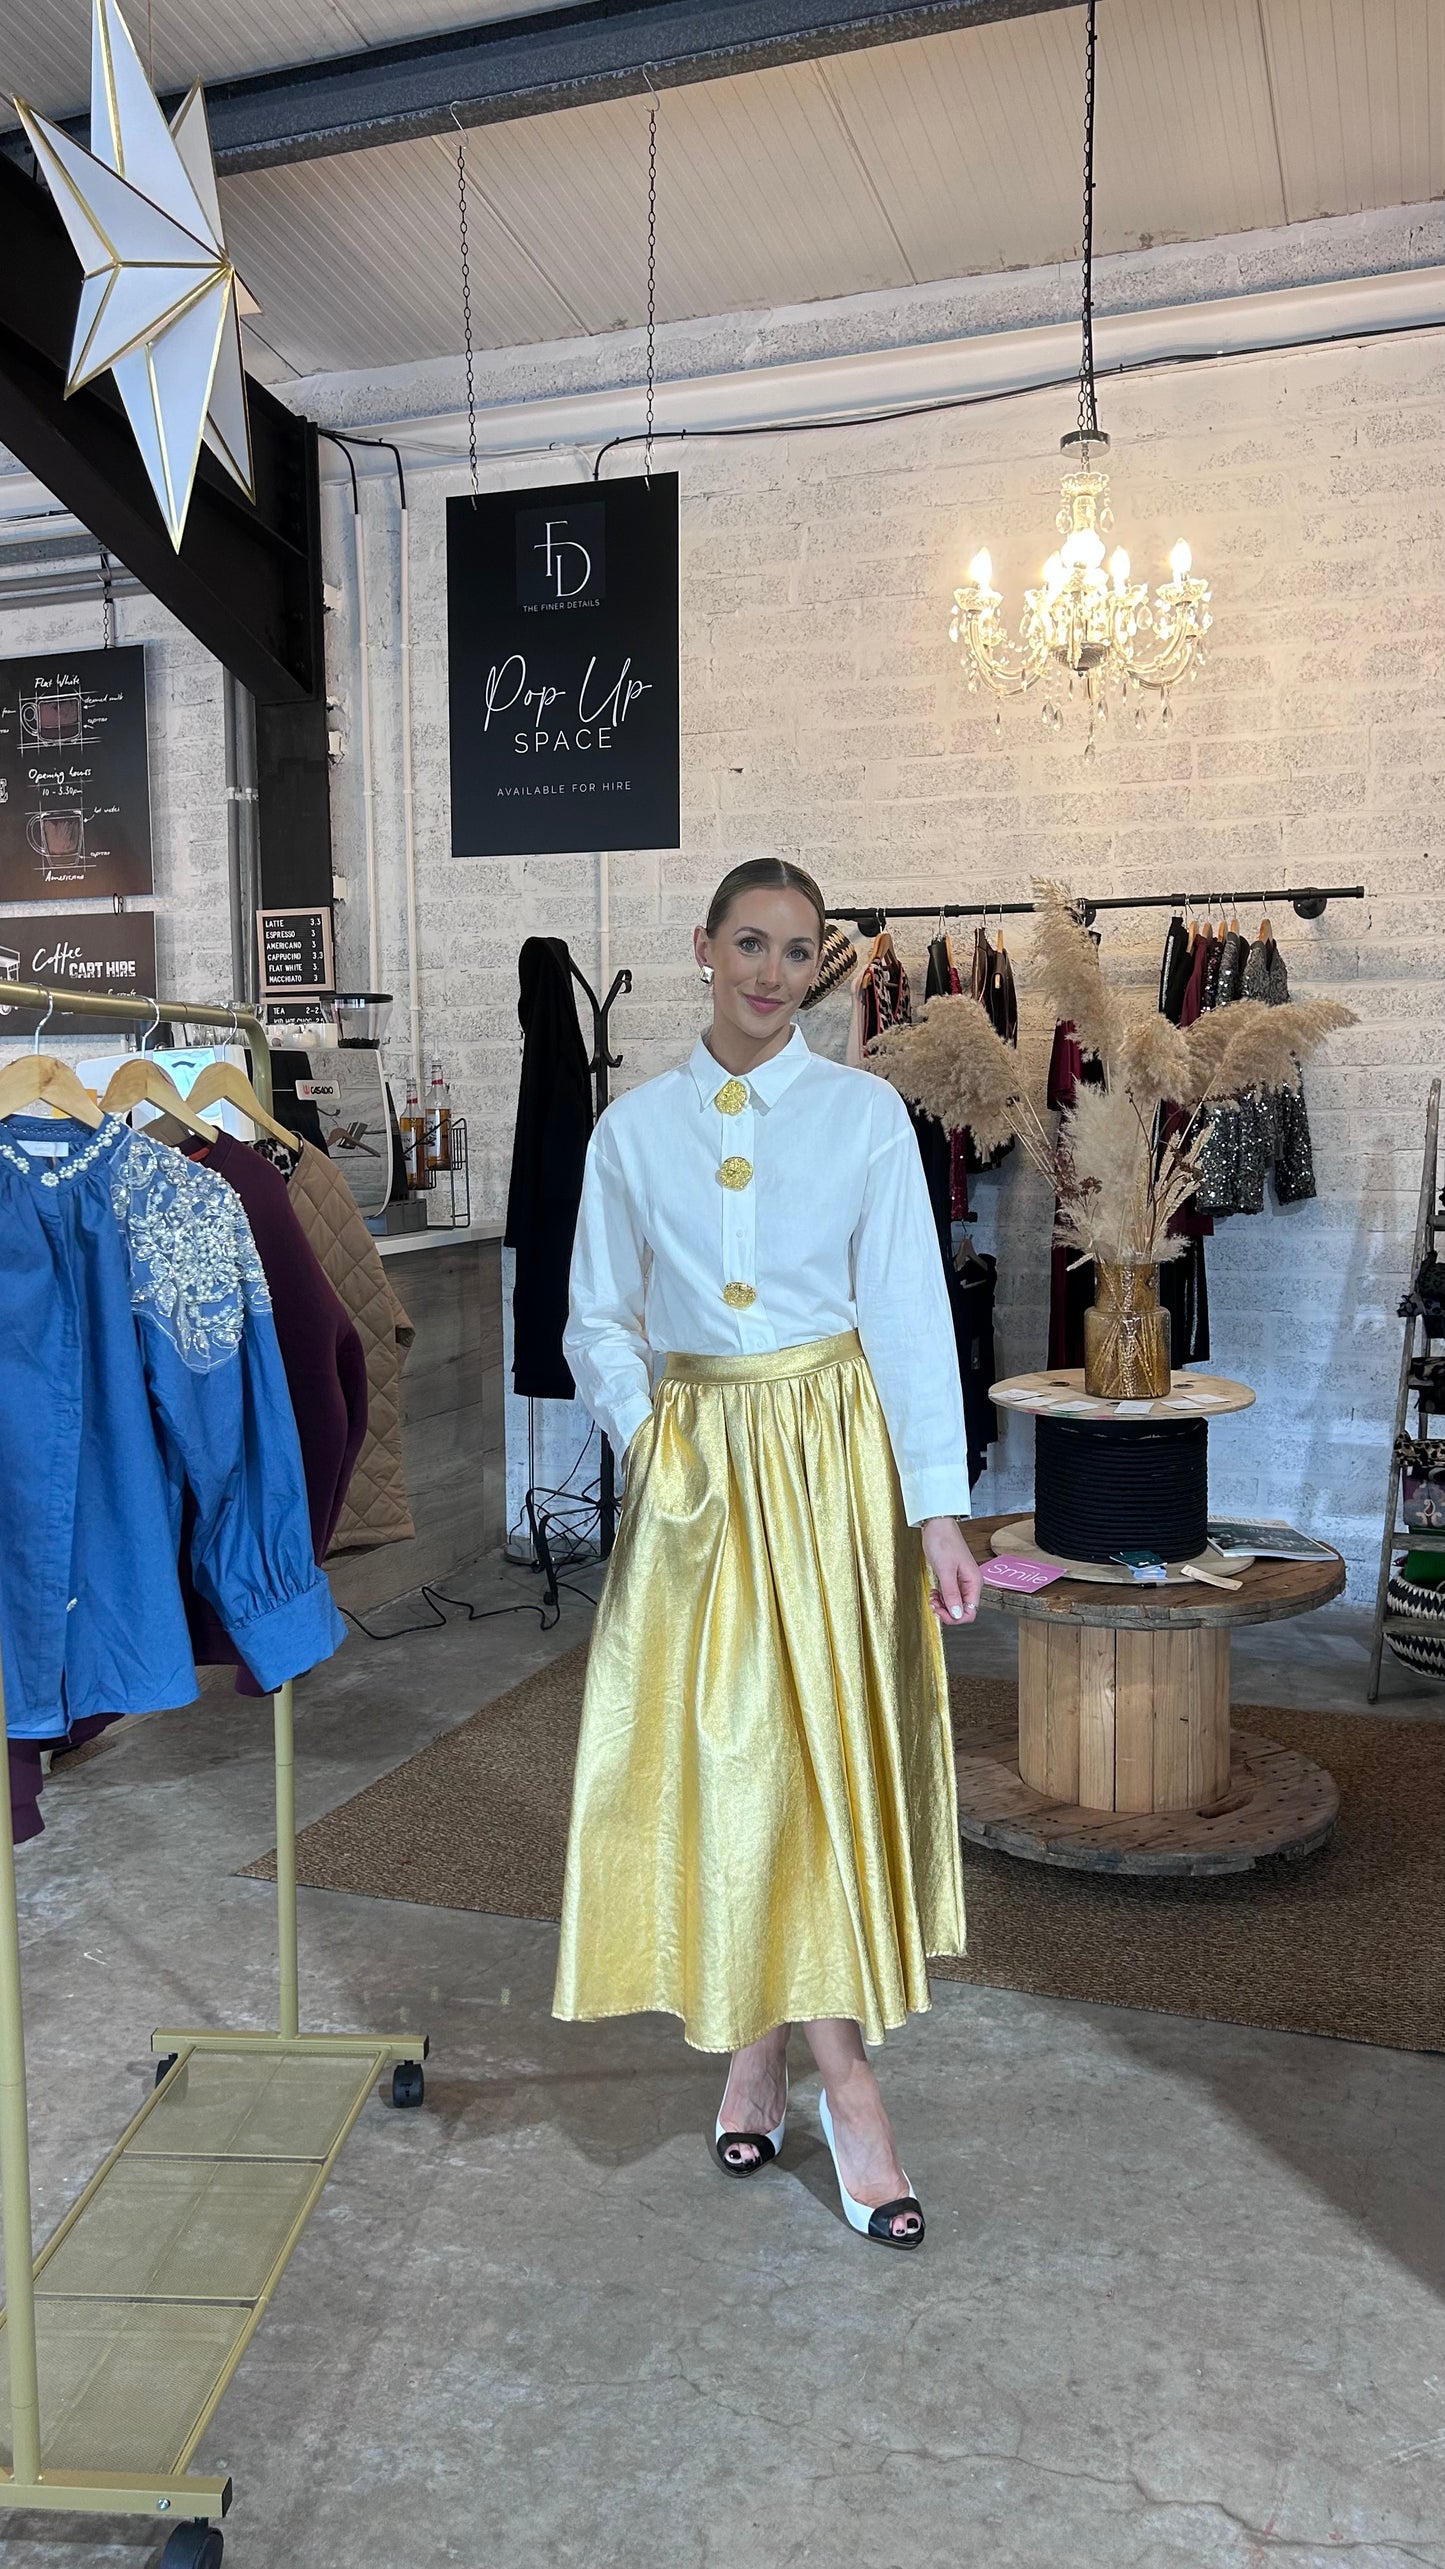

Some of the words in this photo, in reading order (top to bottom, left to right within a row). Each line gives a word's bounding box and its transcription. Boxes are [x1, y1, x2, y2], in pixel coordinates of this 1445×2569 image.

[523, 604, 539, 613] THE
[540, 602, 565, 611] FINER
[566, 598, 600, 609] DETAILS
[34, 677, 53, 688] Flat
[56, 673, 80, 688] White
[484, 654, 566, 731] Pop
[578, 657, 653, 727] Up
[514, 727, 612, 754] SPACE
[28, 767, 65, 785] Opening
[69, 766, 92, 777] hours
[42, 788, 50, 796] 10
[497, 784, 566, 797] AVAILABLE
[571, 782, 596, 793] FOR
[602, 780, 632, 791] HIRE
[44, 870, 85, 882] Americano
[265, 919, 285, 928] LATTE
[265, 930, 296, 939] ESPRESSO
[311, 929, 316, 937] 3
[266, 941, 302, 950] AMERICANO
[311, 940, 317, 949] 3
[31, 941, 83, 975] Coffee
[267, 952, 302, 961] CAPPUCINO
[69, 961, 104, 979] CART
[105, 960, 137, 978] HIRE
[268, 964, 283, 972] FLAT
[284, 963, 303, 972] WHITE
[268, 974, 303, 983] MACCHIATO
[313, 974, 318, 982] 3
[273, 1007, 286, 1015] TEA
[987, 1563, 1049, 1584] smile
